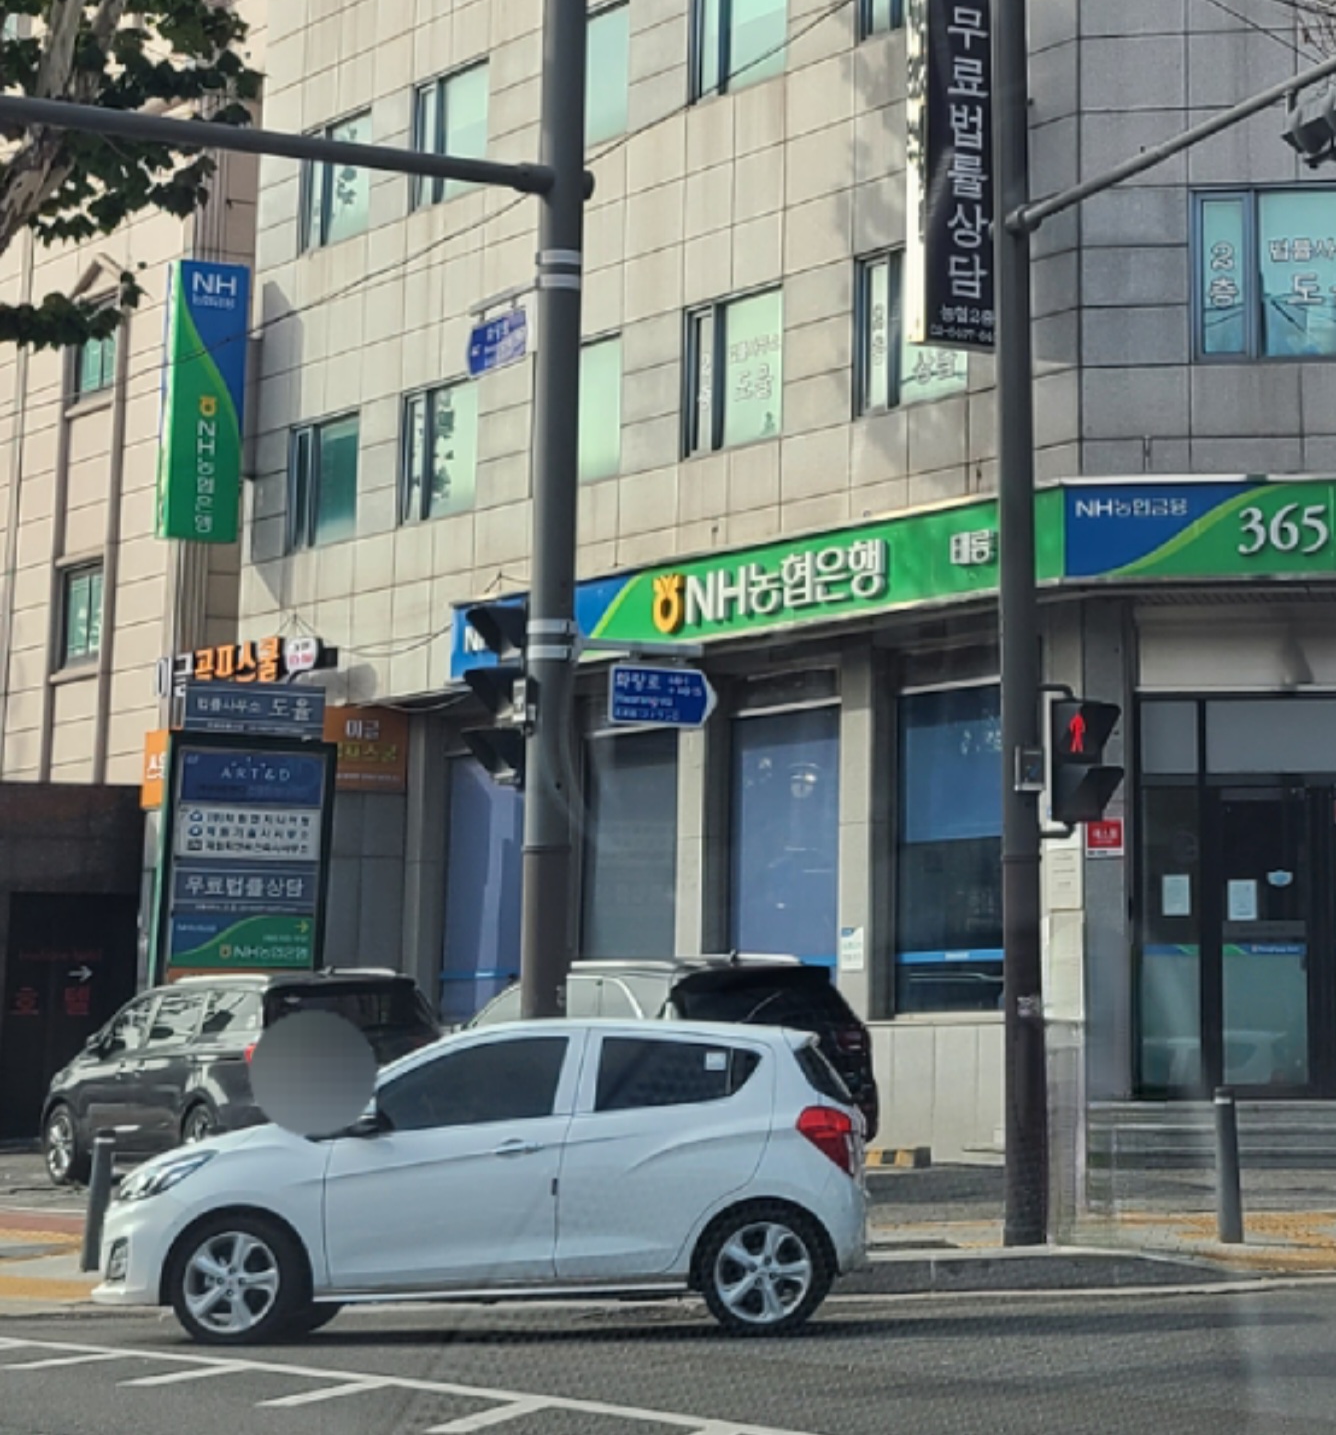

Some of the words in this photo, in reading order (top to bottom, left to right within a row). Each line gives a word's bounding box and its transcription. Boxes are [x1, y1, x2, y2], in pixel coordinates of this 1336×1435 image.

[946, 6, 989, 299] 무료법률상담
[192, 272, 237, 297] NH
[1210, 241, 1238, 308] 2층
[1075, 497, 1188, 519] NH농협금융
[1237, 502, 1330, 556] 365
[684, 538, 887, 623] NH농협은행
[616, 671, 662, 692] 화랑로
[268, 697, 314, 722] 도율
[184, 875, 305, 898] 무료법률상담
